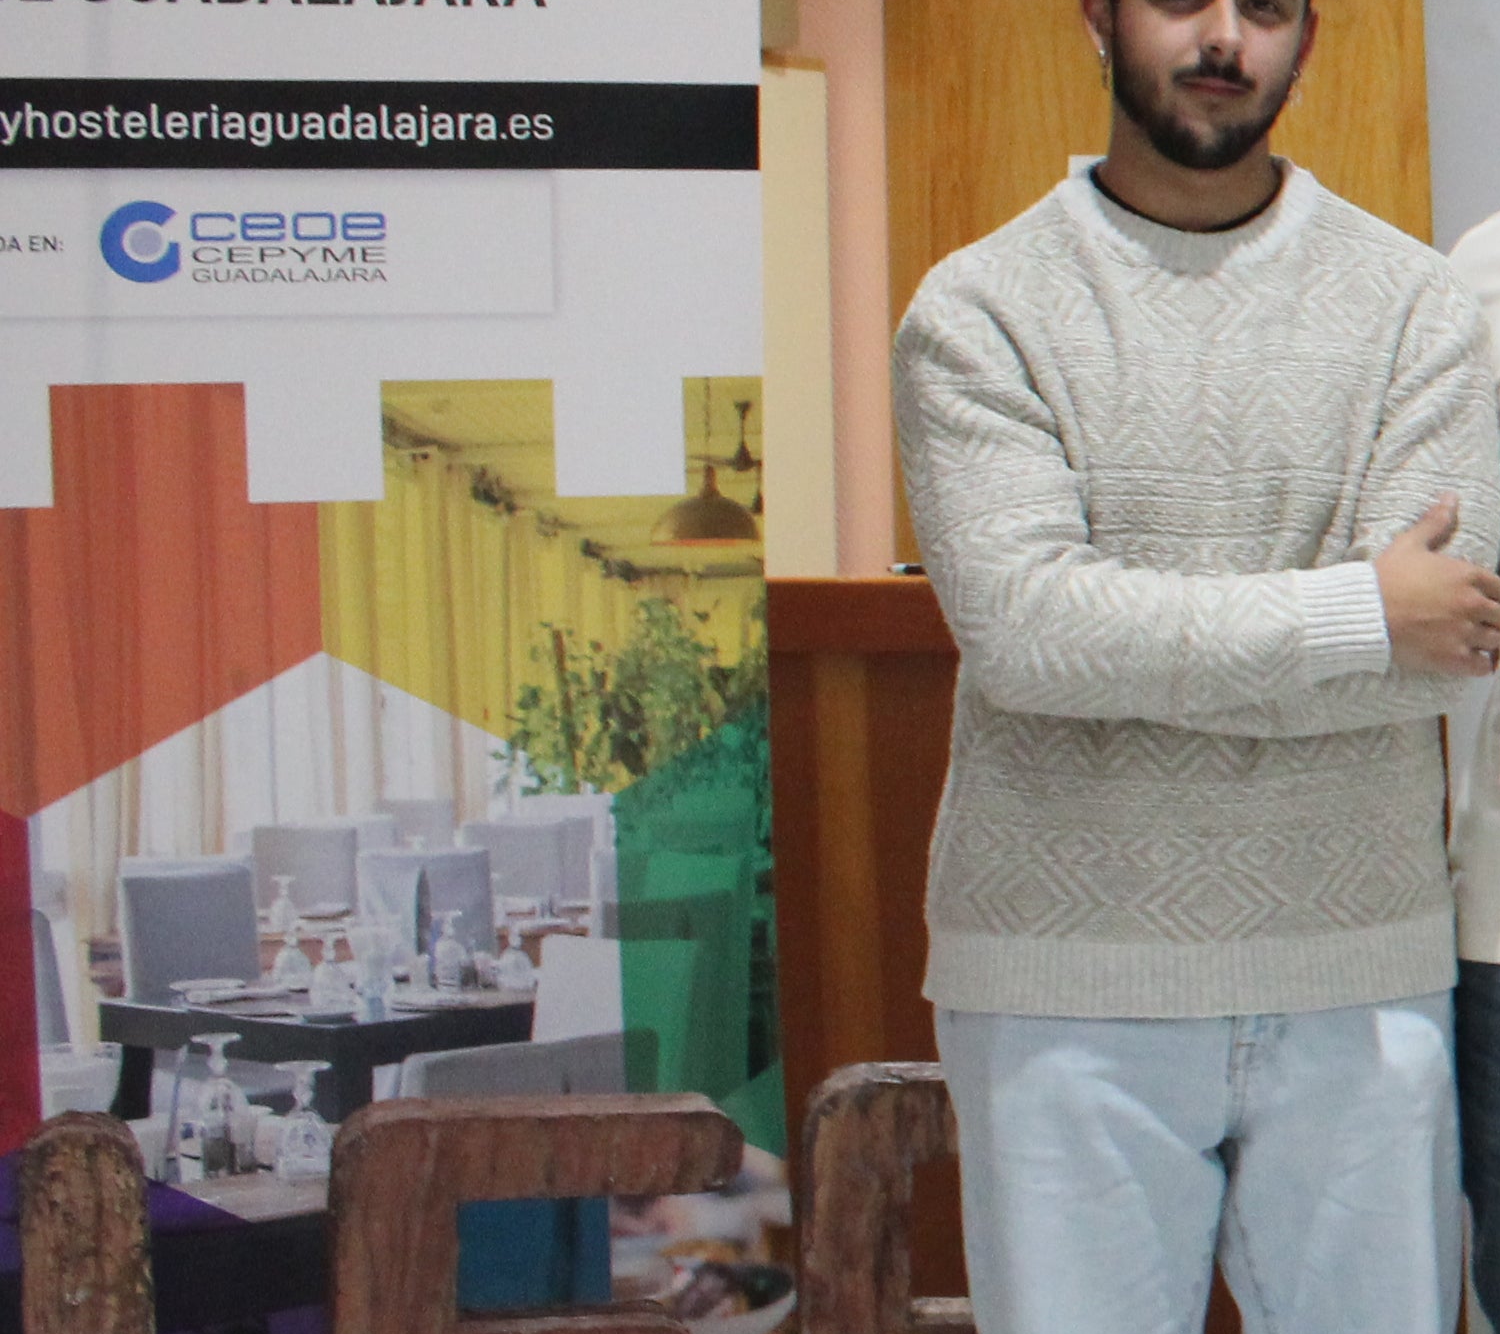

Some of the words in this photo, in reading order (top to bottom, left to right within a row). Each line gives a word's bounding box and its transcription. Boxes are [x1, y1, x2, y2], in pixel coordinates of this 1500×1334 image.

[29, 236, 64, 253] EN:
[191, 246, 388, 265] CEPYME
[192, 268, 388, 283] GUADALAJARA
